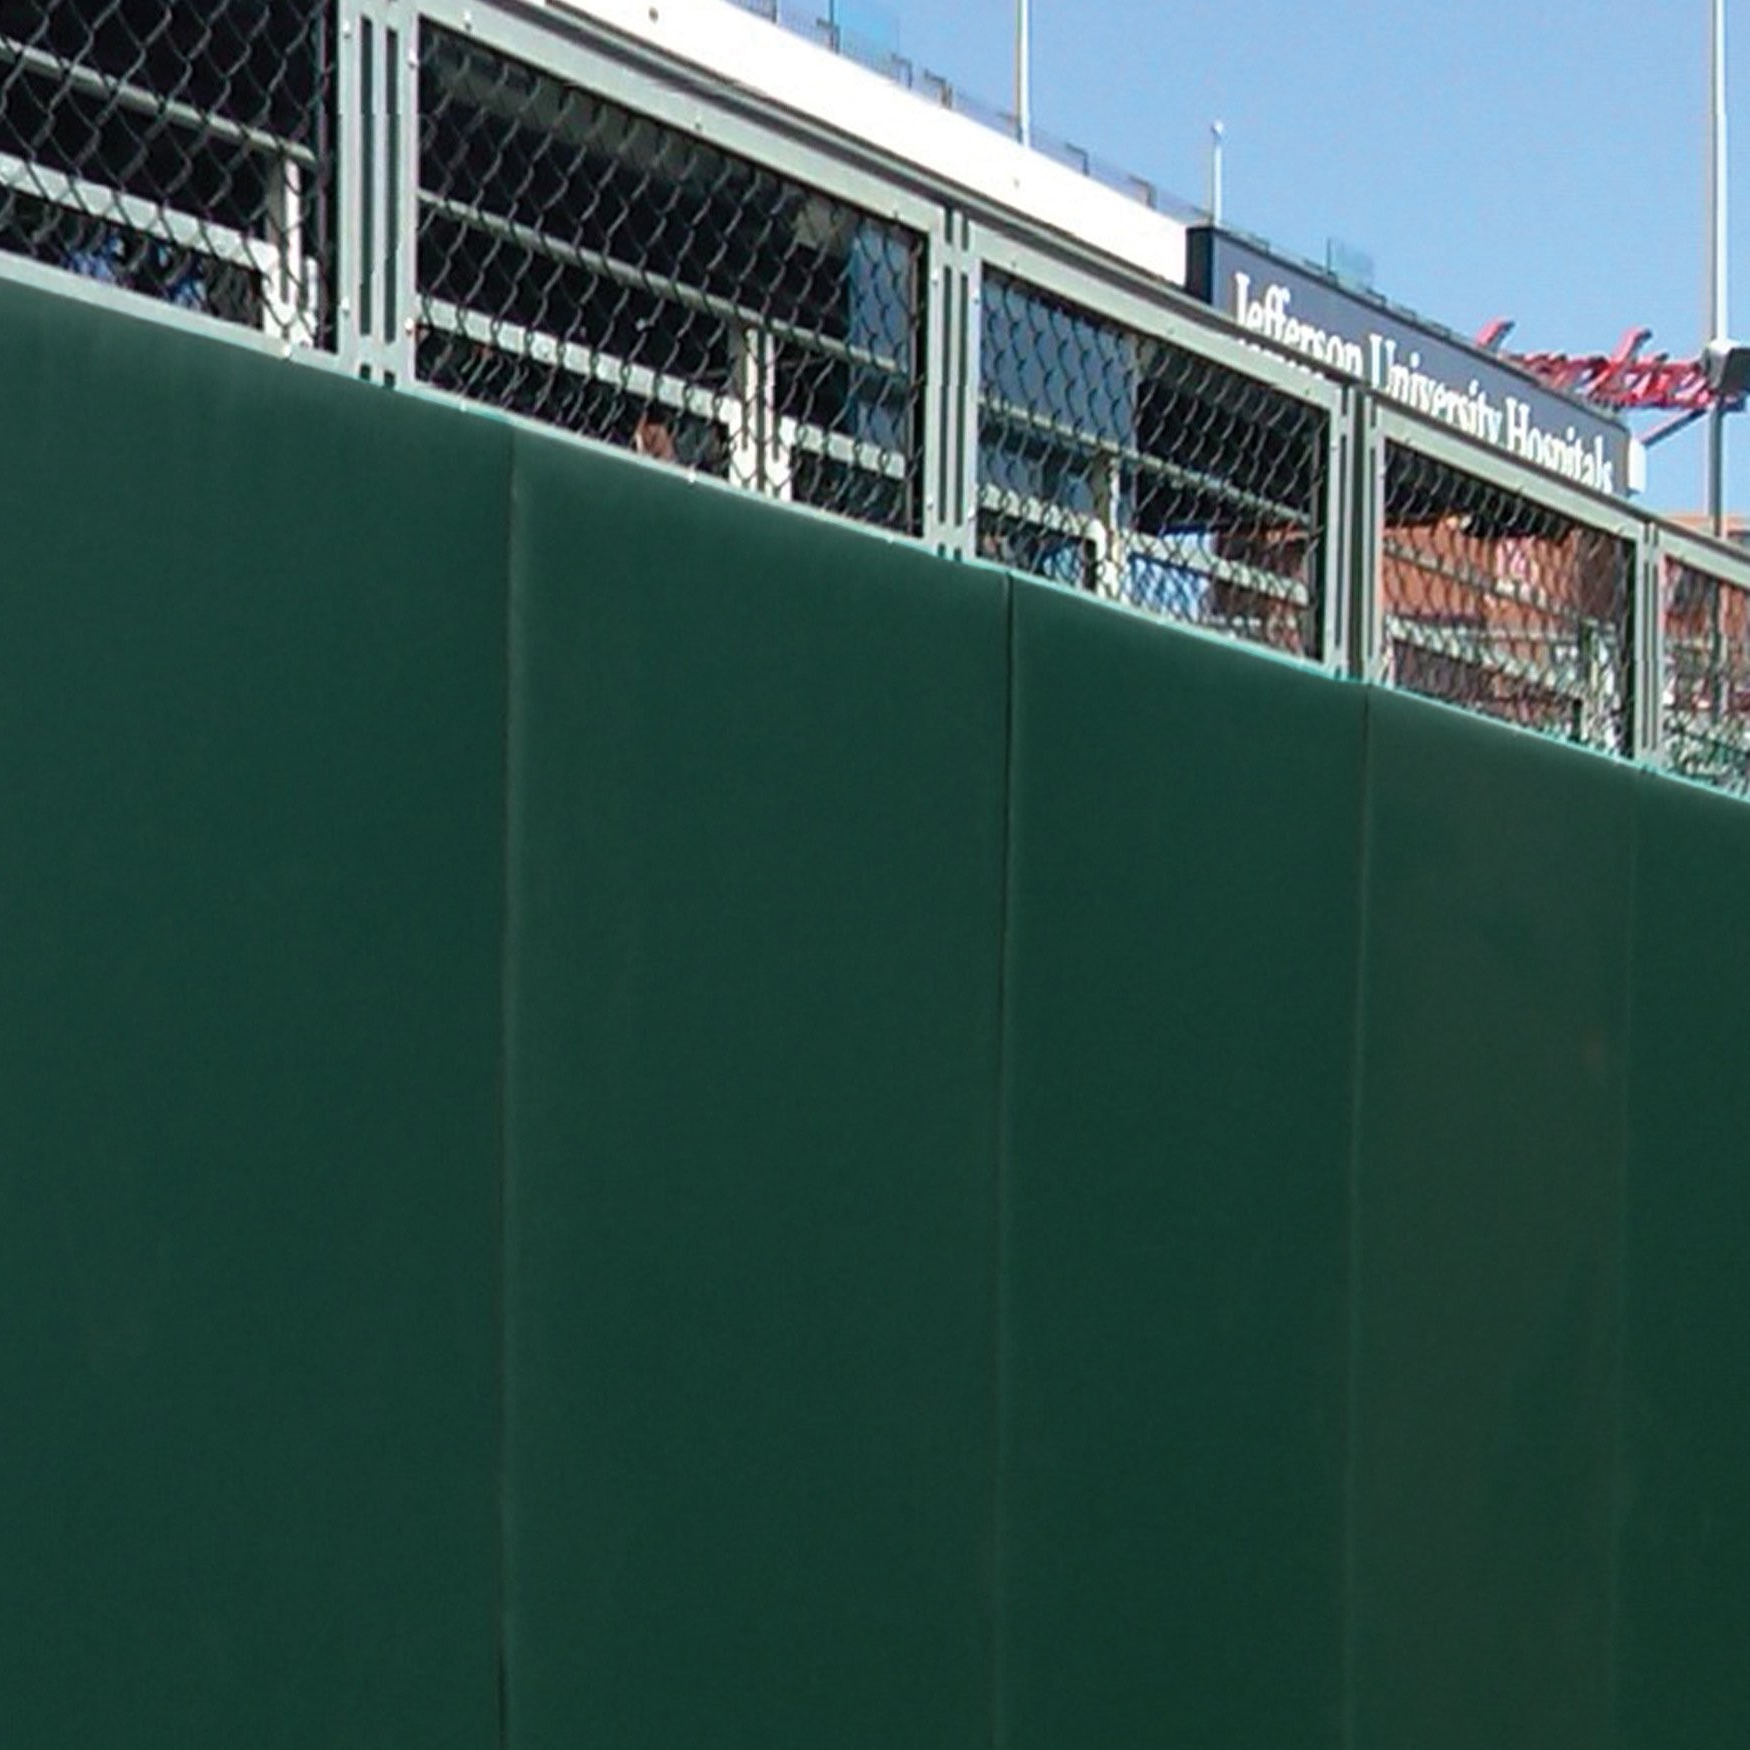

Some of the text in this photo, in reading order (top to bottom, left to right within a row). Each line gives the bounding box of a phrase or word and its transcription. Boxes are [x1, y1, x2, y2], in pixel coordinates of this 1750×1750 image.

[1234, 272, 1364, 378] Jefferson
[1368, 333, 1503, 445] University
[1505, 396, 1614, 494] Hospitals
